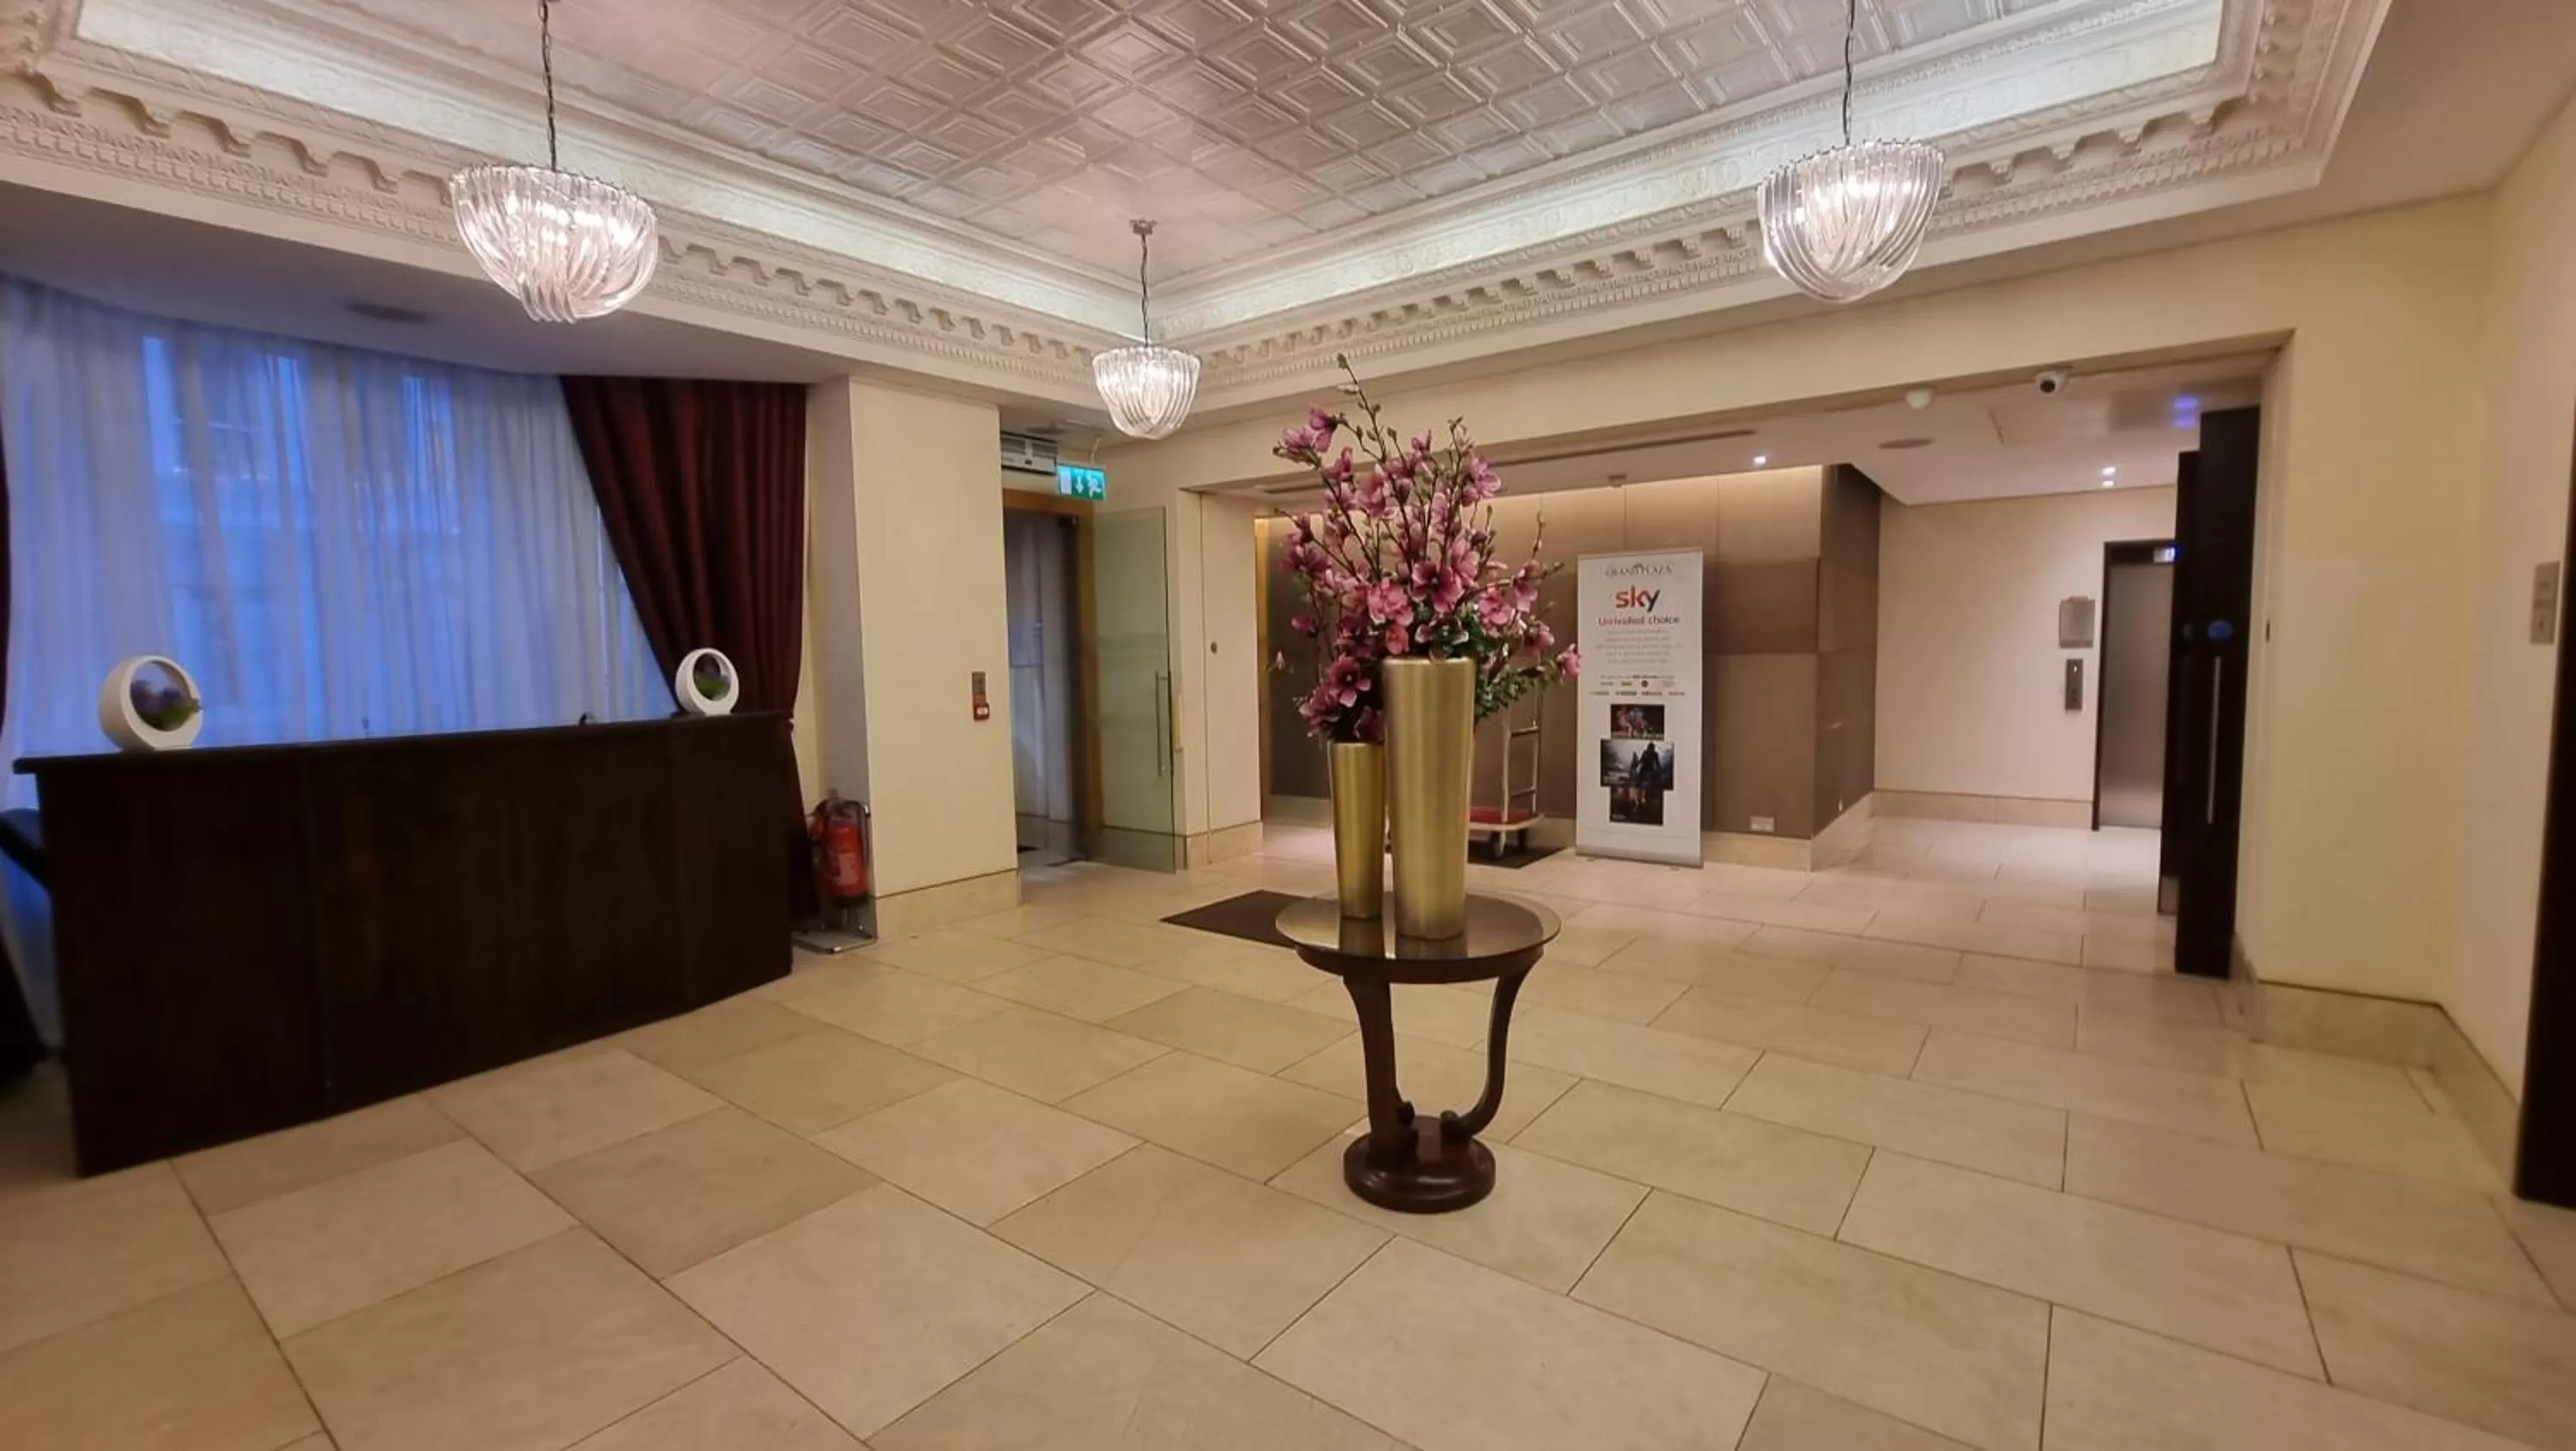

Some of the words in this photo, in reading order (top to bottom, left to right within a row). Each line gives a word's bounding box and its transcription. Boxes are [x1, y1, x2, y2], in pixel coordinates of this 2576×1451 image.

[1605, 566, 1637, 578] GRAND
[1639, 564, 1673, 577] PLAZA
[1615, 585, 1662, 612] sky
[1597, 616, 1645, 627] Unrivalled
[1648, 613, 1680, 626] choice
